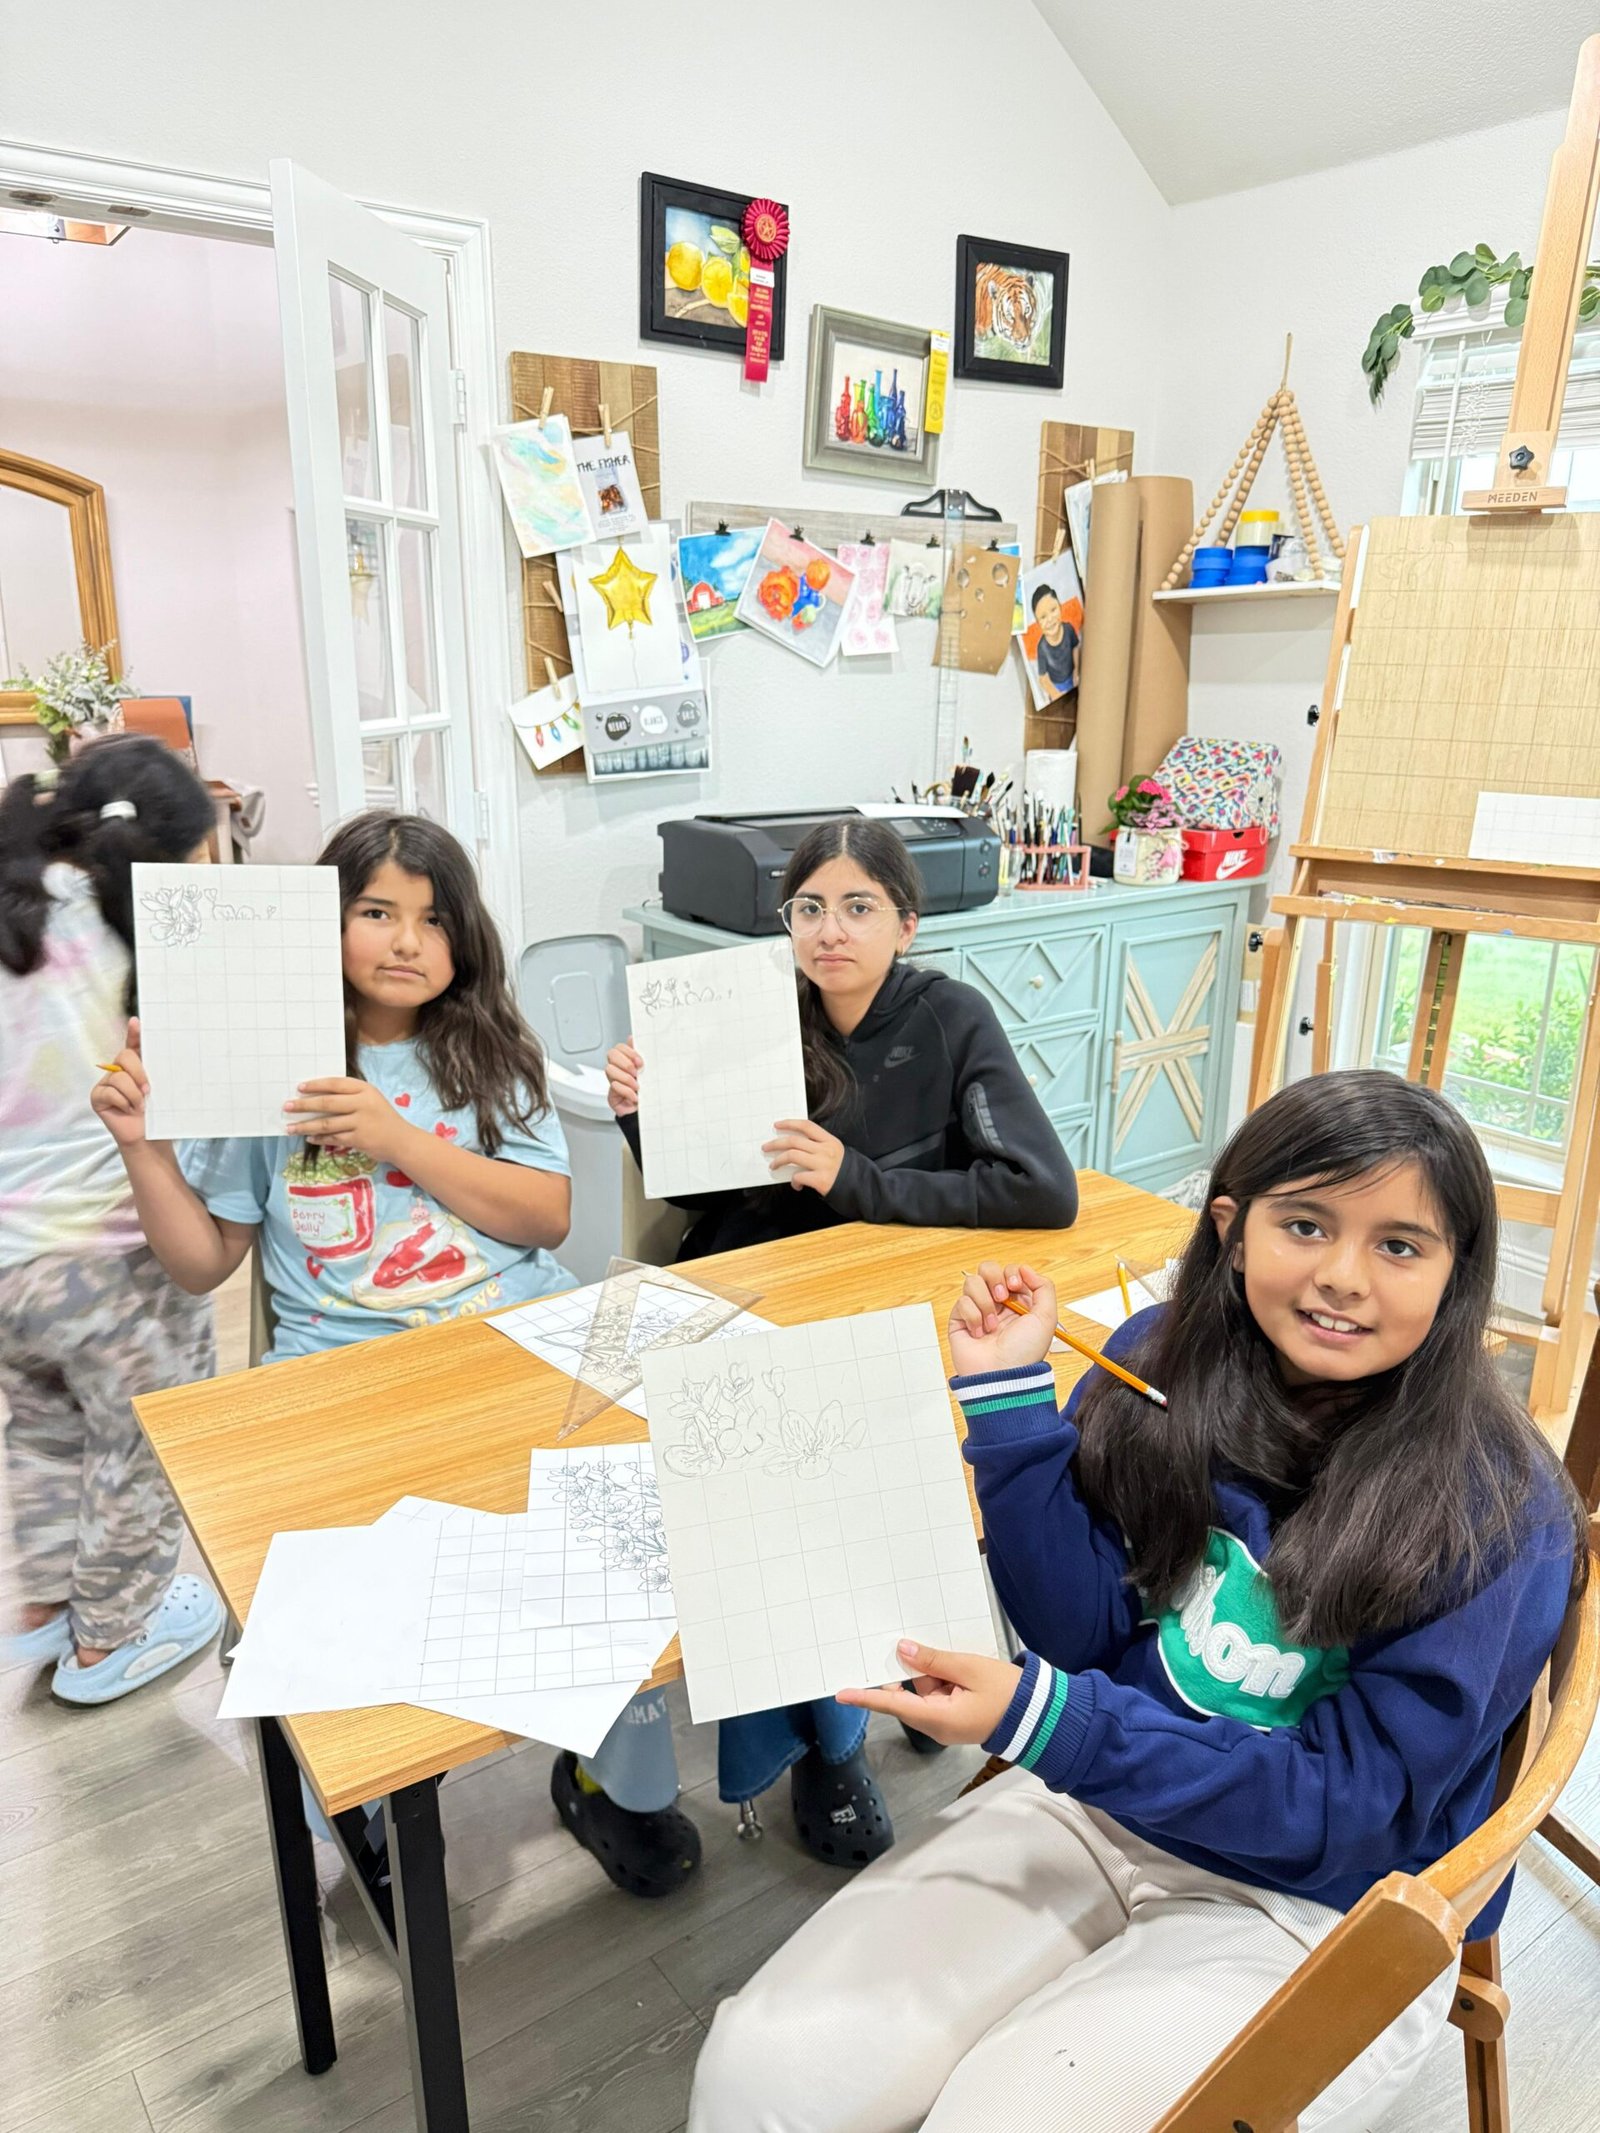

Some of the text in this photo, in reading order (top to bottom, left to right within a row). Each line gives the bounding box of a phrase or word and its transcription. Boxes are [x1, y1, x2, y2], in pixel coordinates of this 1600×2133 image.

[1487, 490, 1538, 504] MEEDEN
[1223, 849, 1248, 866] NIKE
[890, 1045, 915, 1059] NIKE
[294, 1220, 320, 1237] Jelly
